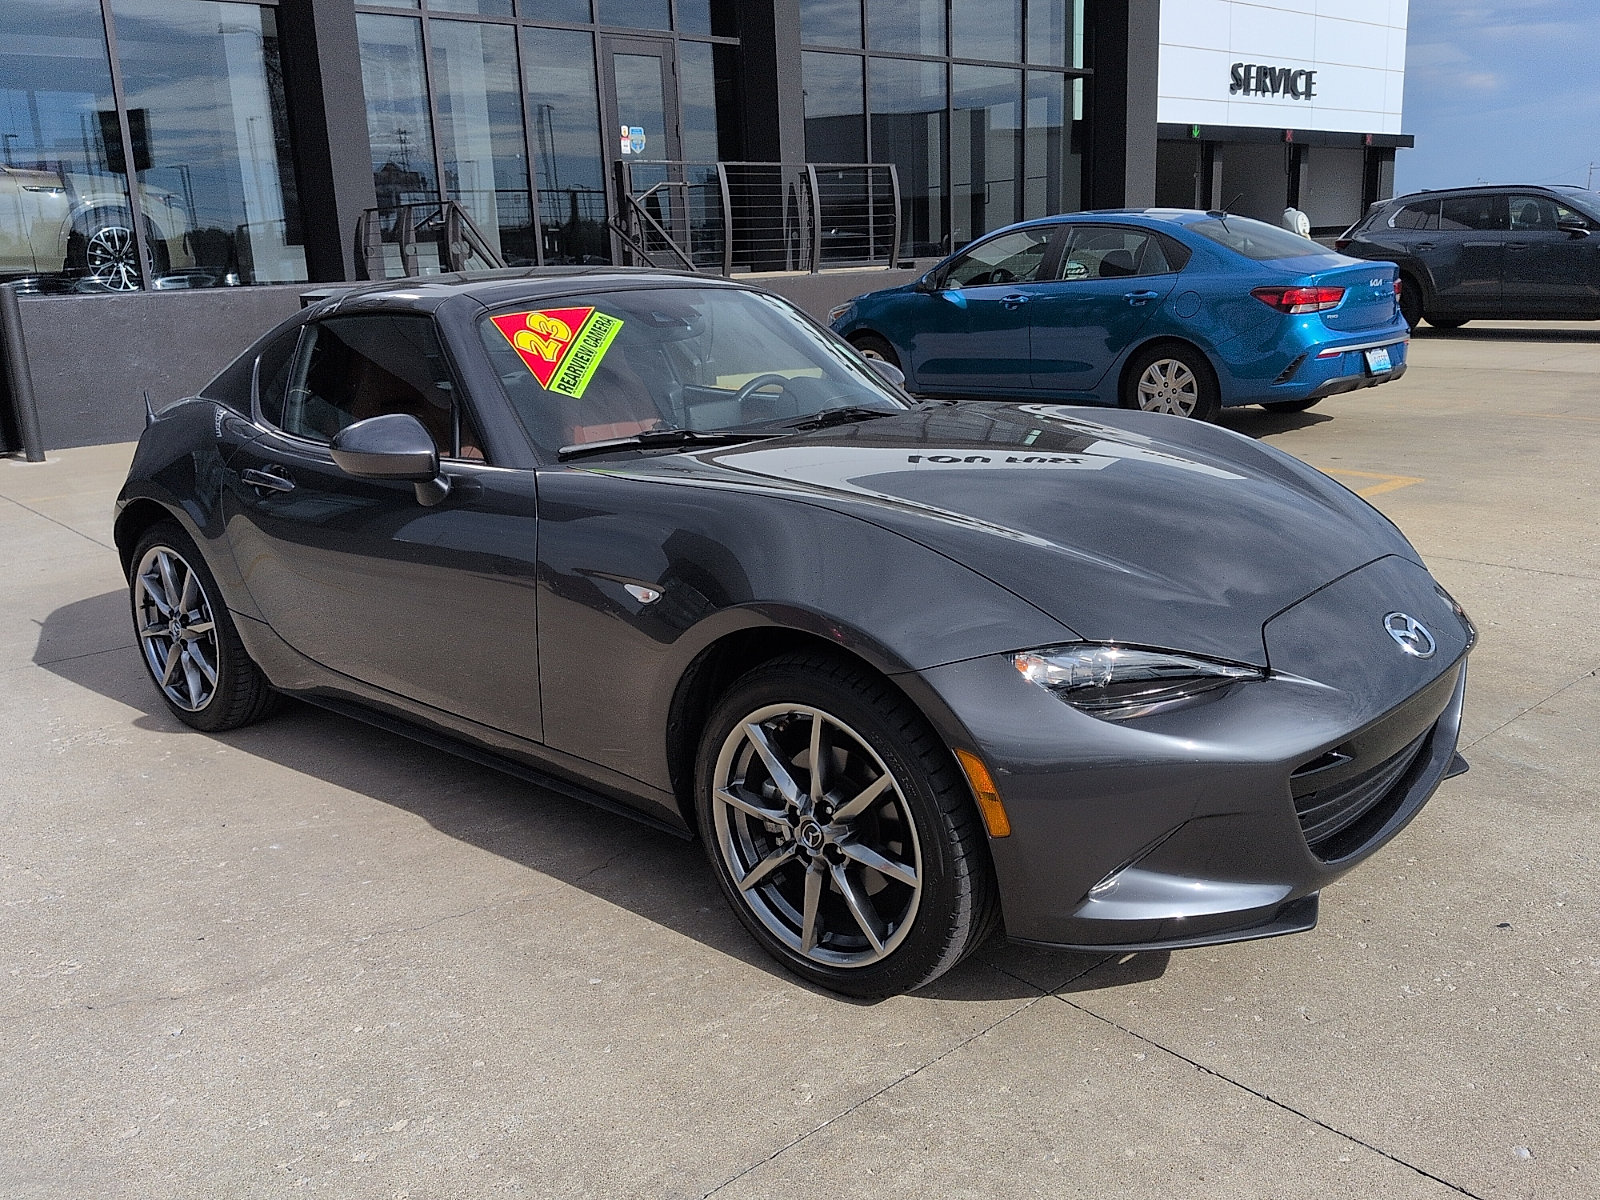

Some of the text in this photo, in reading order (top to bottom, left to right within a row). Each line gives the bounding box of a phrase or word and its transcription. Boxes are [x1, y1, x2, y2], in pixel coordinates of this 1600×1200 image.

[1229, 62, 1318, 101] SERVICE
[513, 312, 572, 362] 23
[557, 341, 595, 395] REARVIEW
[585, 315, 614, 349] CAMERA
